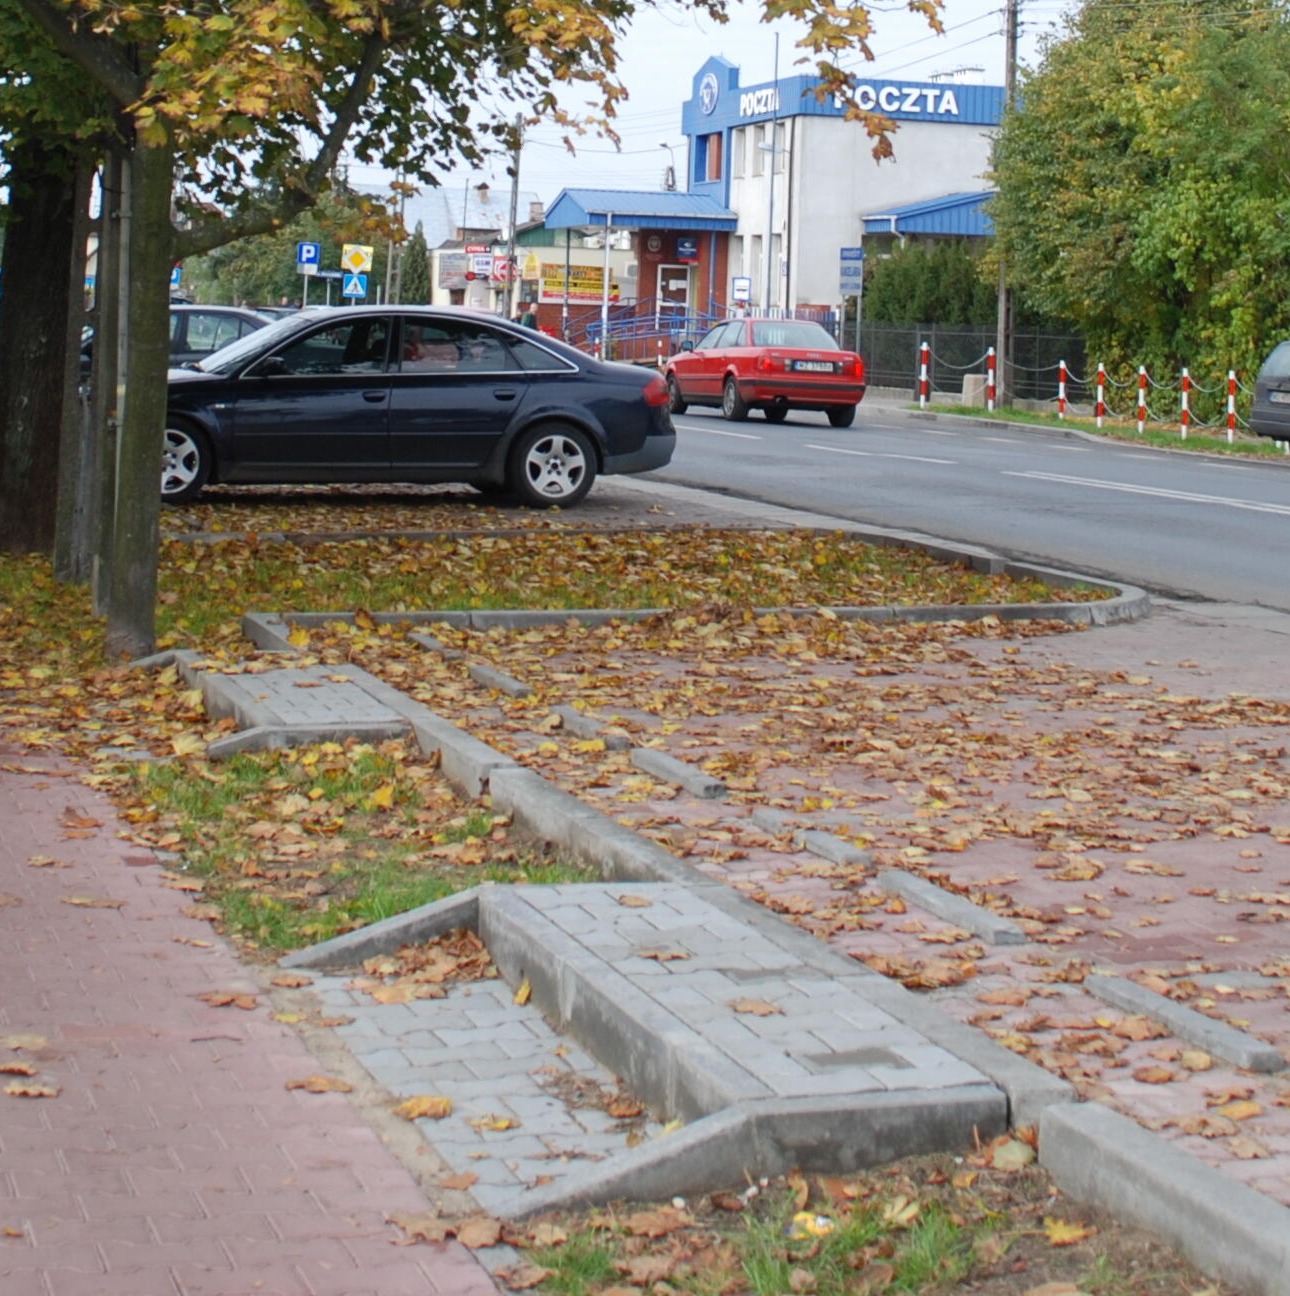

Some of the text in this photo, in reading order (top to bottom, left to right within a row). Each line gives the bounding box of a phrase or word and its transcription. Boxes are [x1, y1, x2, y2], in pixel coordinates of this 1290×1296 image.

[740, 87, 779, 117] POCZTA
[834, 85, 959, 115] POCZTA
[302, 245, 315, 262] P
